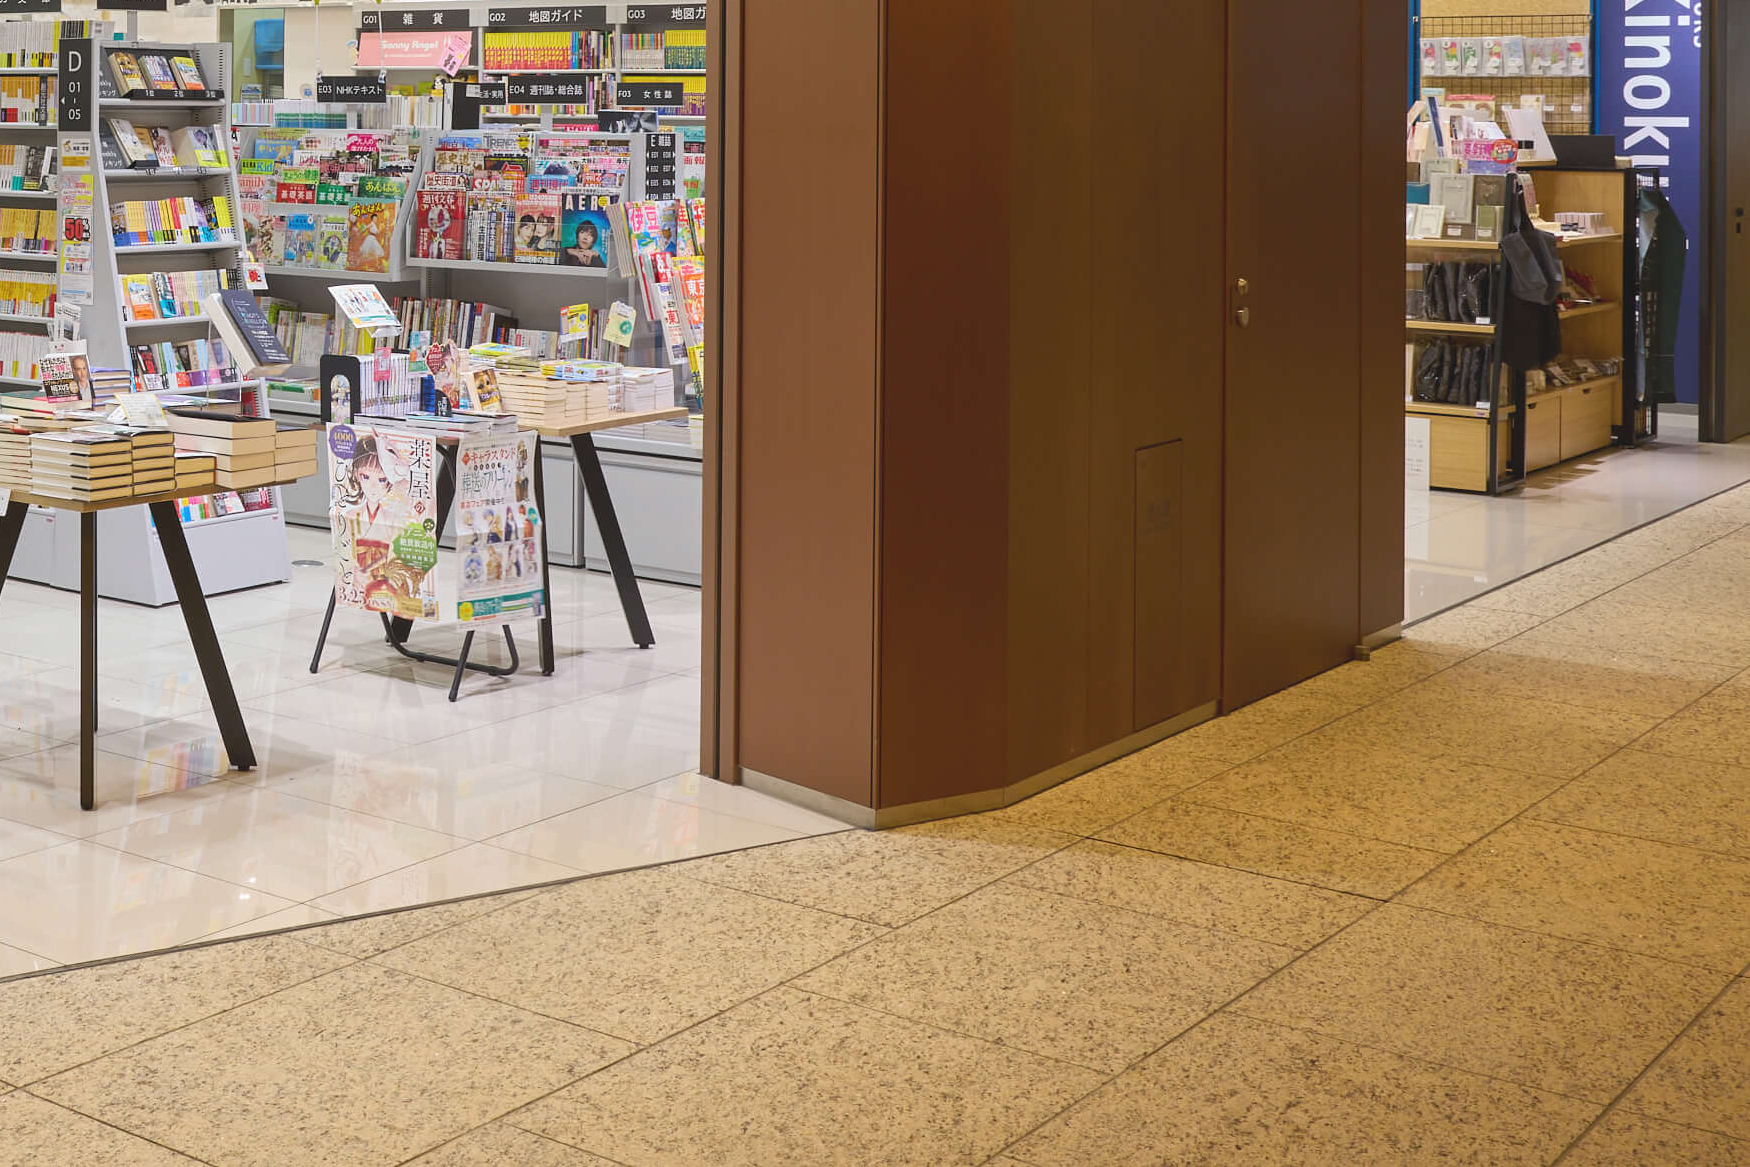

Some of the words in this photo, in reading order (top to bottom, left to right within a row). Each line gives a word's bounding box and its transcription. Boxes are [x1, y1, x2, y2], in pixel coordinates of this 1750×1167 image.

[363, 15, 377, 24] G01
[402, 12, 443, 25] 雑貨
[489, 13, 506, 23] G02
[528, 8, 583, 23] 地図ガイド
[627, 9, 646, 19] G03
[68, 51, 82, 72] D
[68, 82, 81, 93] 01
[318, 85, 332, 94] E03
[336, 85, 383, 95] NHKテキスト
[509, 85, 525, 95] E04
[529, 85, 583, 96] 週刊誌・総合誌
[618, 89, 632, 98] F03
[643, 89, 673, 99] 女性誌
[68, 109, 81, 120] 05
[630, 204, 660, 233] 伊豆
